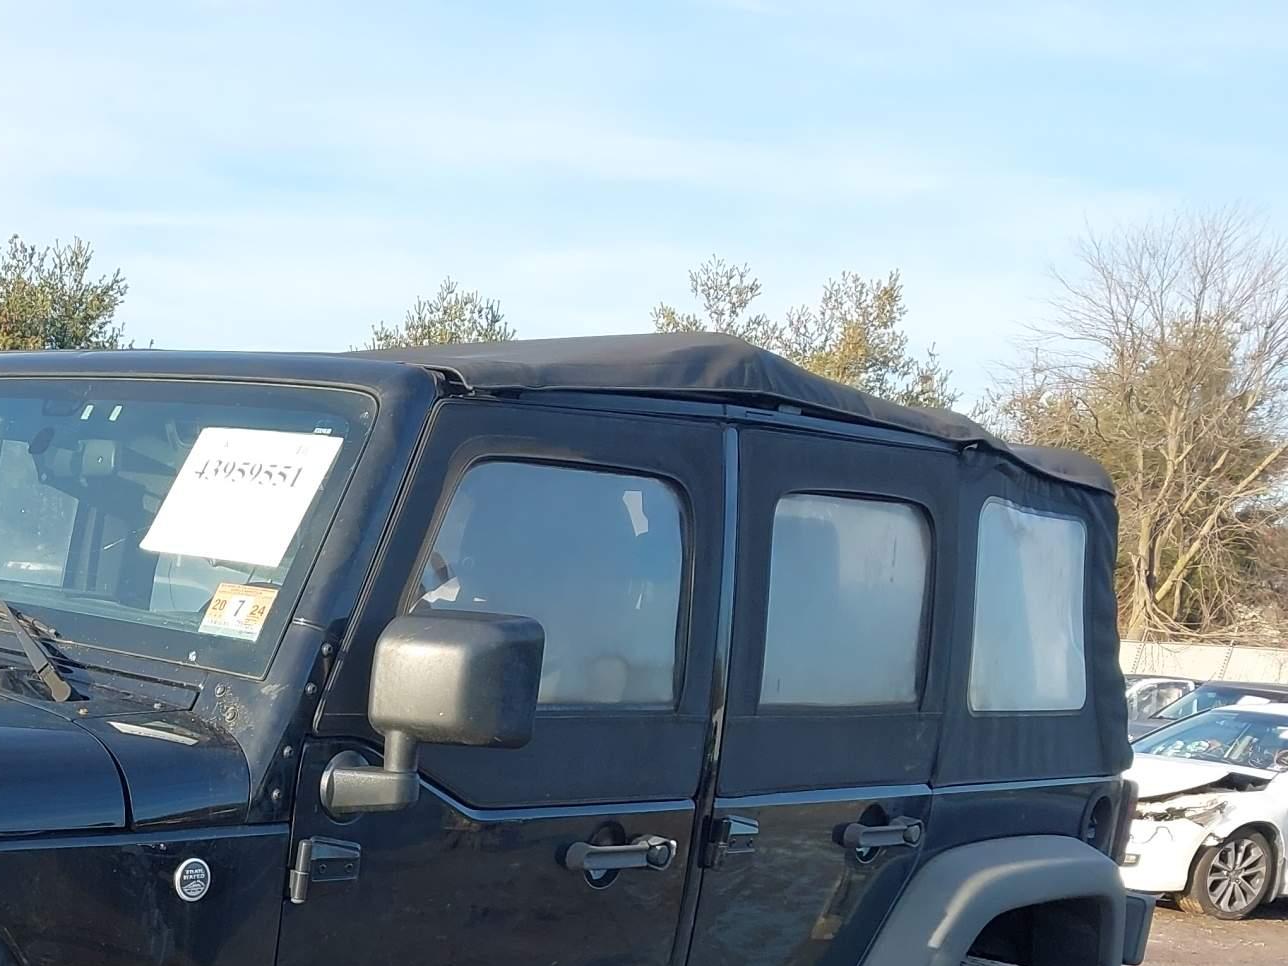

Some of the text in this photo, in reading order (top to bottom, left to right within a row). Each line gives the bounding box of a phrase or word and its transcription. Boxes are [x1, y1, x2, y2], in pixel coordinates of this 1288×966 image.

[195, 459, 303, 487] 43959551
[212, 599, 266, 617] 20 7 24
